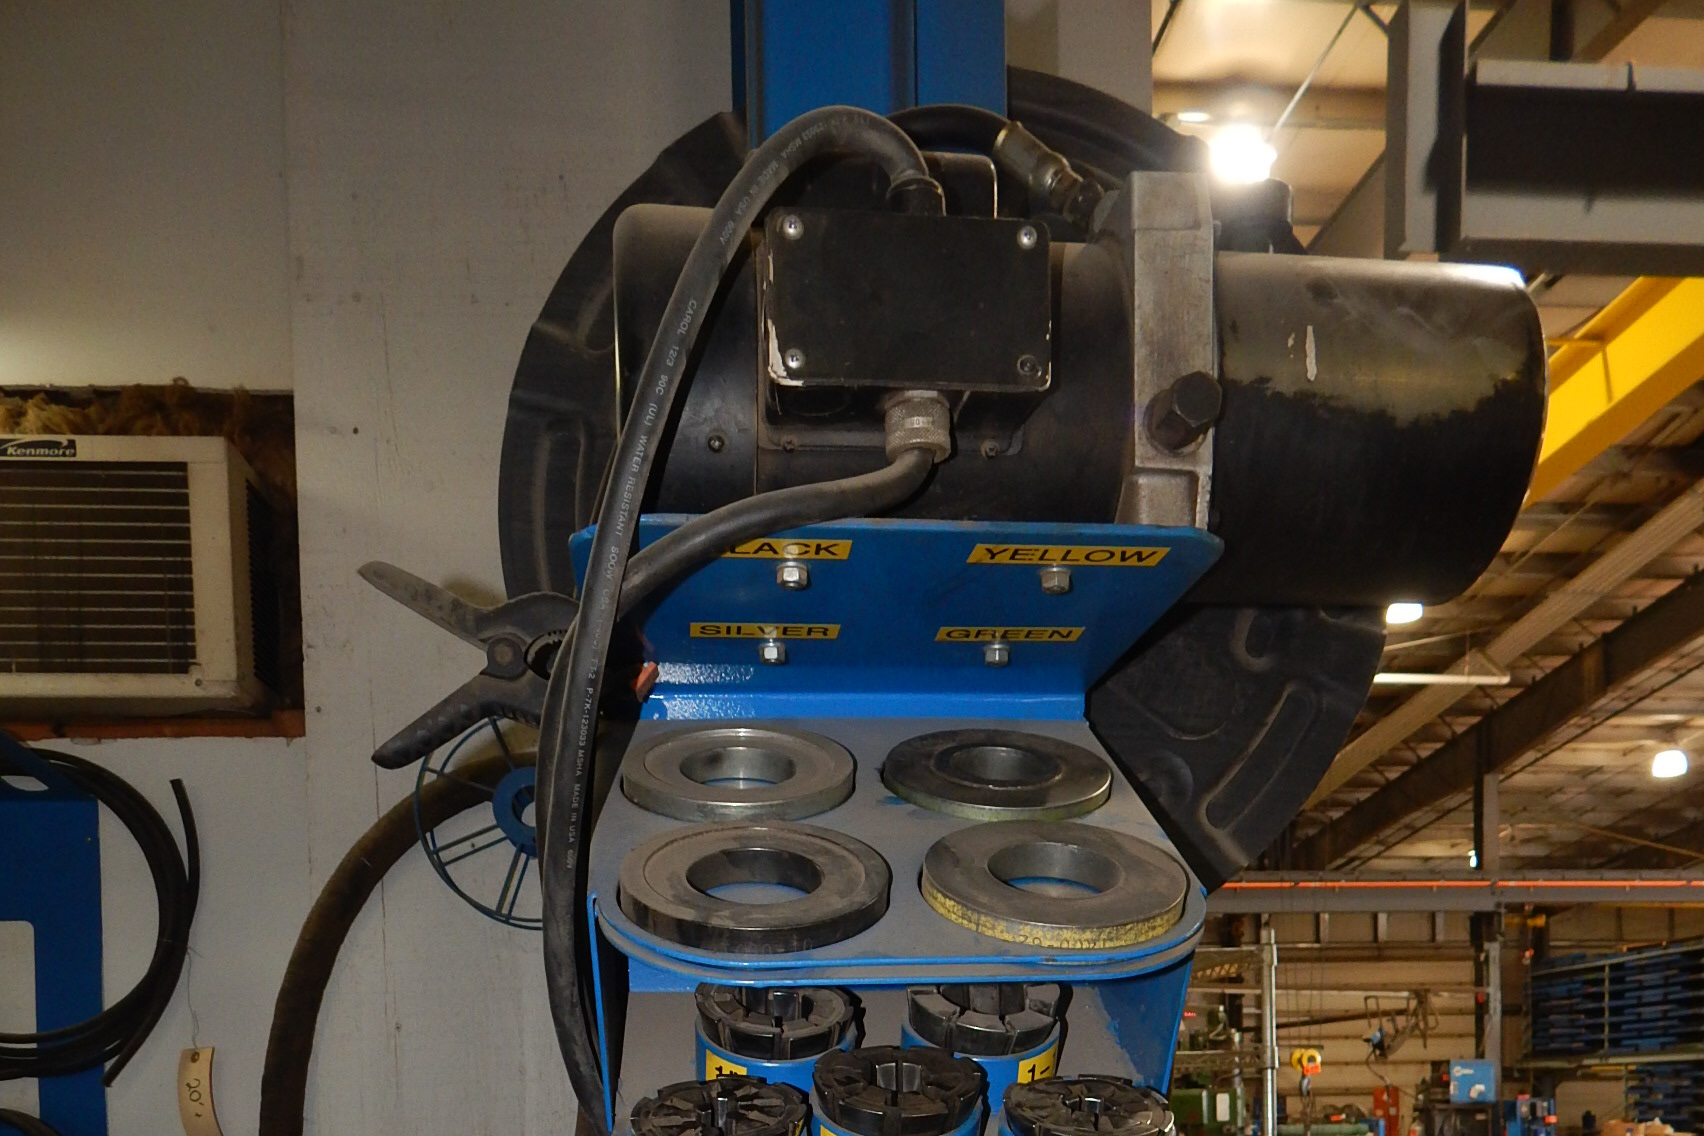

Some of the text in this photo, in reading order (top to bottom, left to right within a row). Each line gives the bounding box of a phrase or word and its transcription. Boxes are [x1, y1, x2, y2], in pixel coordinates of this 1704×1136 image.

[757, 159, 779, 187] MADE
[749, 184, 759, 195] IN
[735, 195, 752, 216] USA
[719, 220, 735, 245] 600V
[677, 300, 697, 335] CAROL
[666, 345, 679, 367] 12/3
[656, 374, 668, 395] 90C
[7, 446, 75, 456] Kenmore
[631, 435, 648, 473] WATER
[615, 476, 636, 537] RESISTANT
[729, 543, 840, 556] LACK
[984, 547, 1158, 563] YELLOW
[606, 545, 619, 581] SOOW
[699, 625, 829, 637] SILVER
[945, 629, 1074, 640] GREEN
[575, 749, 585, 777] MSHA
[571, 783, 581, 809] MADE
[570, 812, 577, 822] IN
[568, 825, 576, 843] USA
